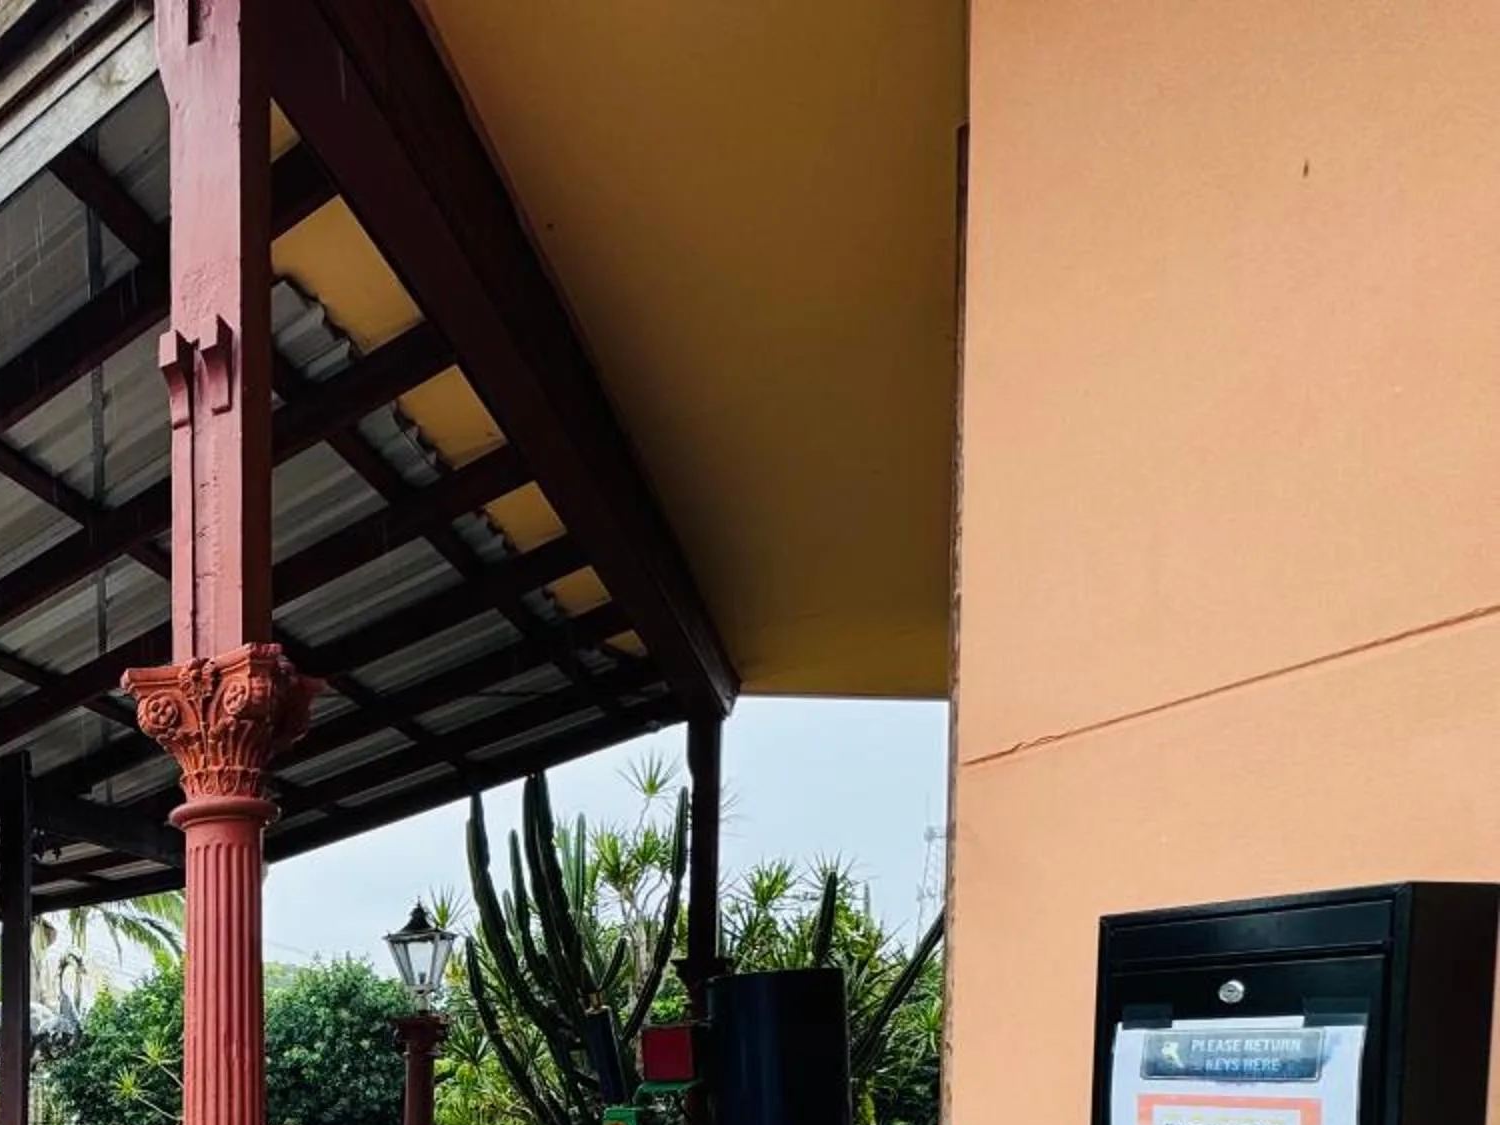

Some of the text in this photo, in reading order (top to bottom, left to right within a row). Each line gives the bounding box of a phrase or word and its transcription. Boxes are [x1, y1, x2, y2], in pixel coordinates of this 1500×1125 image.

[1190, 1038, 1301, 1053] PLEASE RETURN
[1204, 1057, 1281, 1072] KEYS HERE
